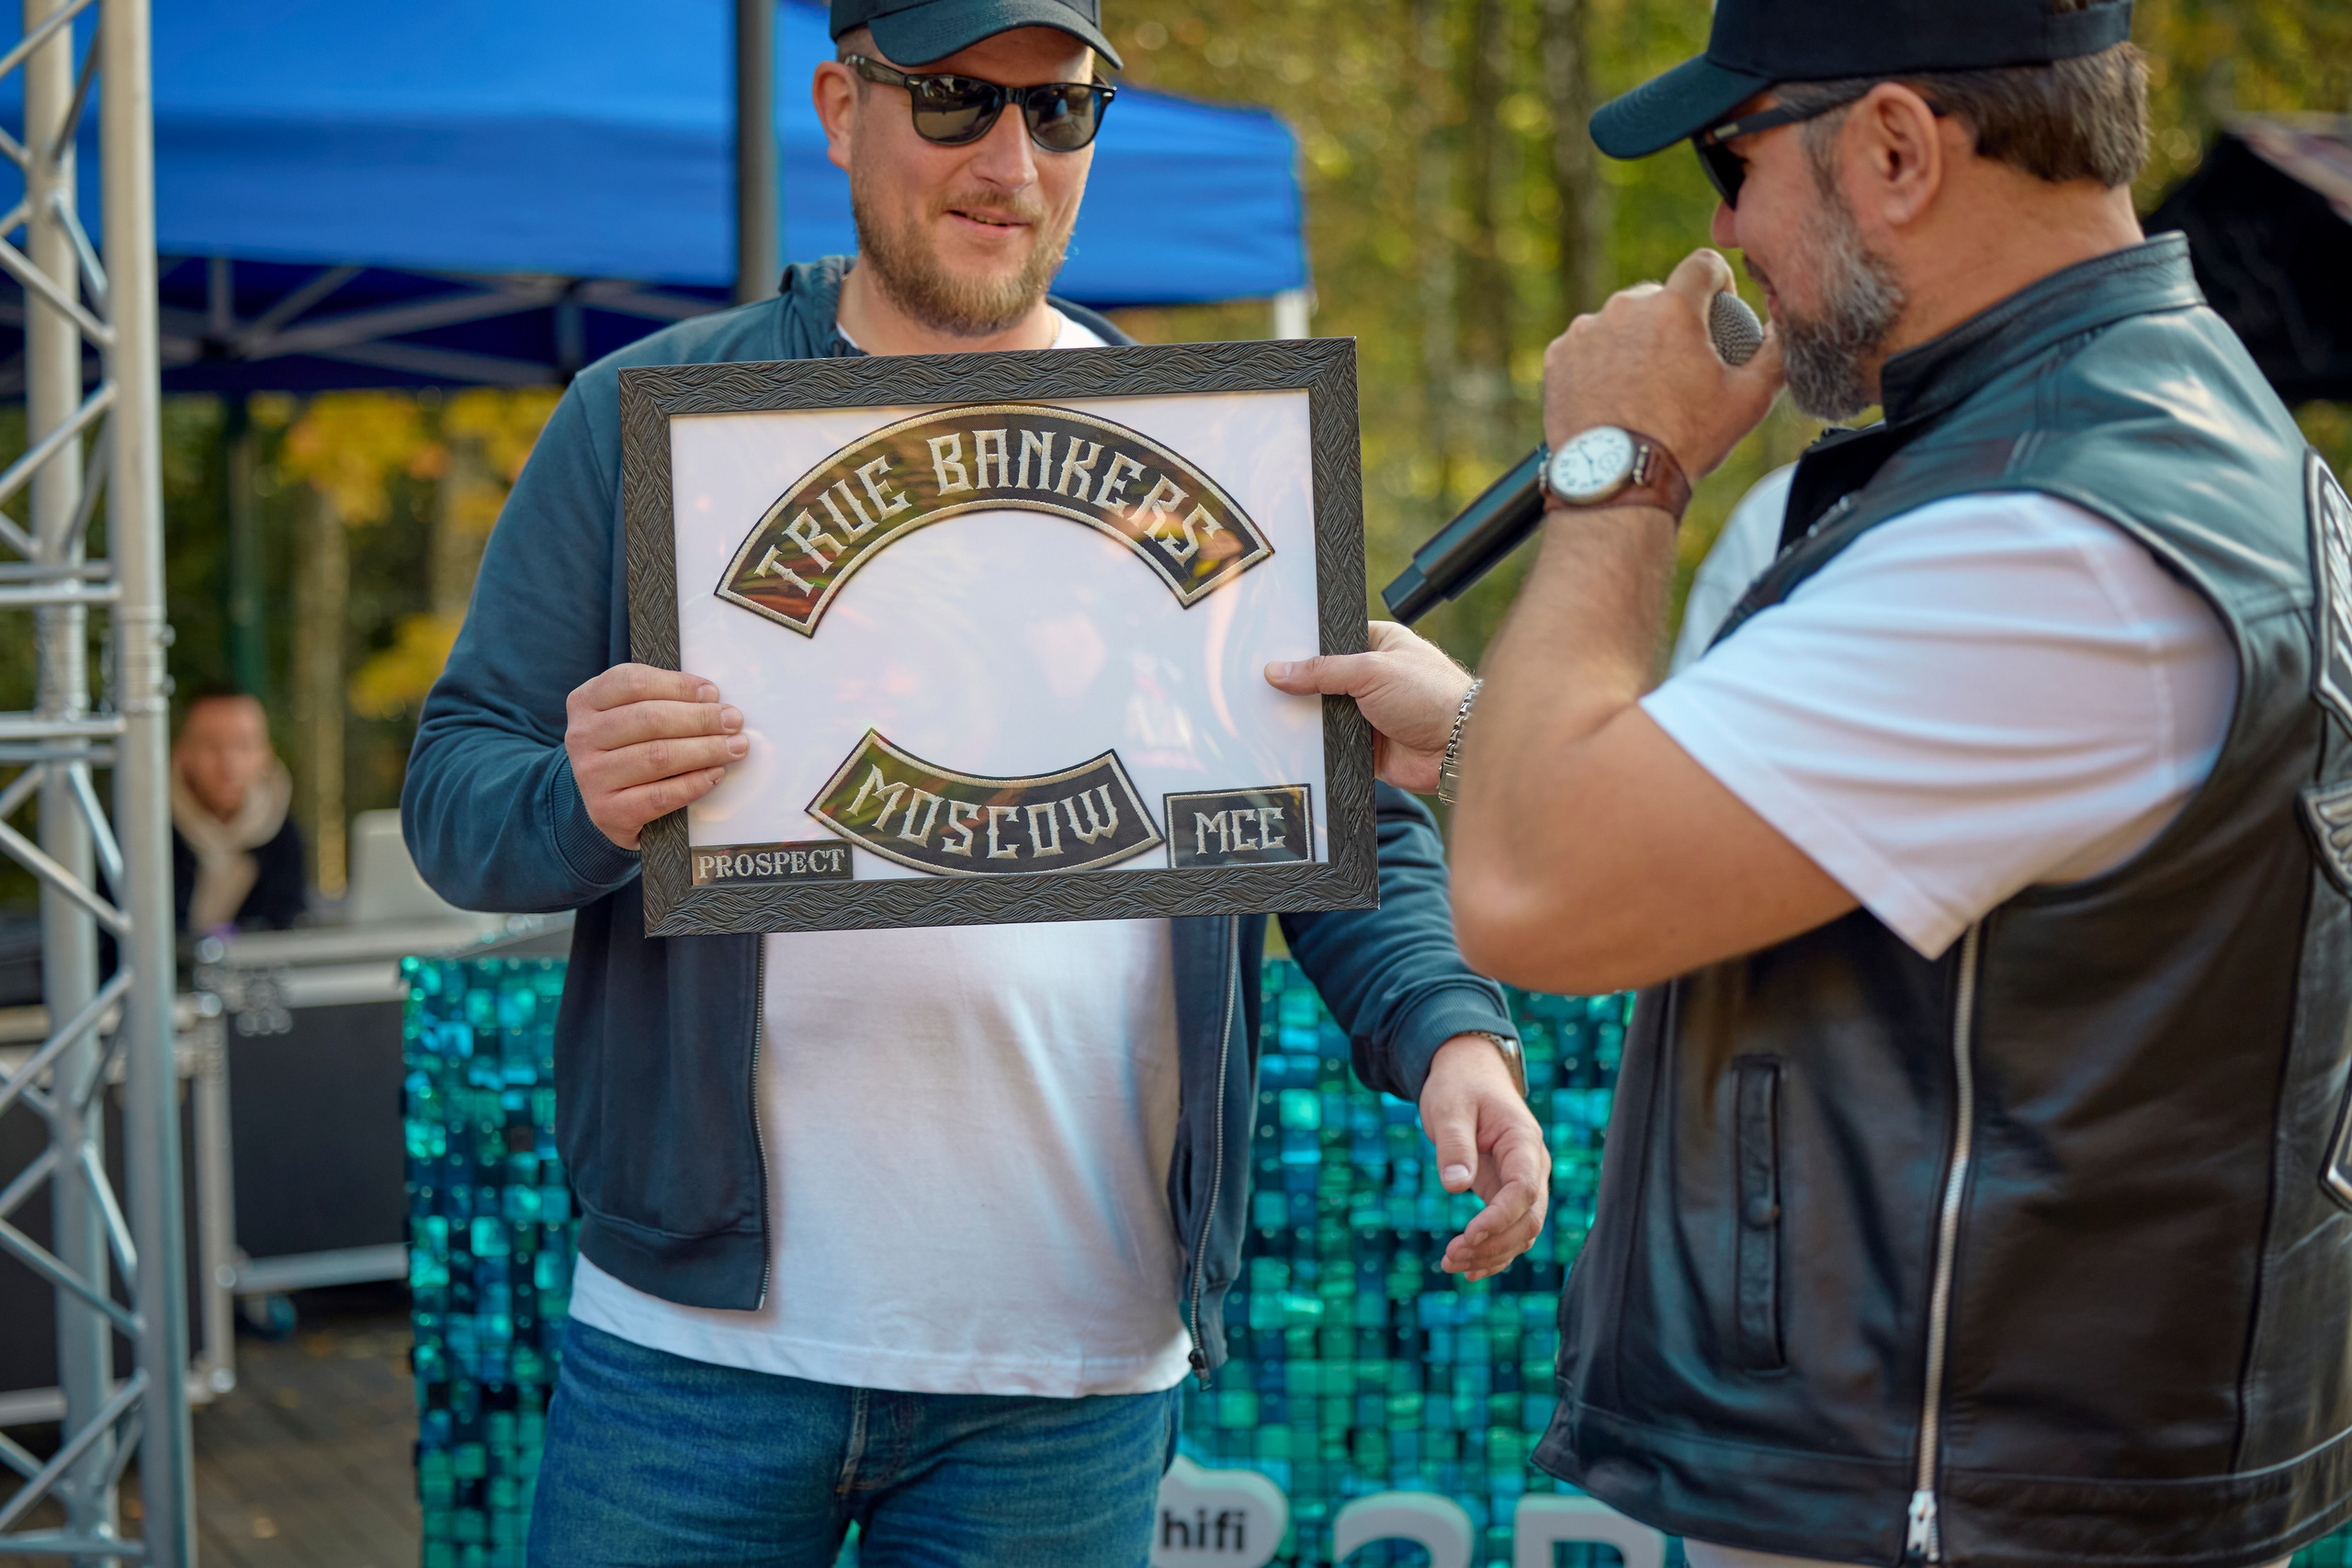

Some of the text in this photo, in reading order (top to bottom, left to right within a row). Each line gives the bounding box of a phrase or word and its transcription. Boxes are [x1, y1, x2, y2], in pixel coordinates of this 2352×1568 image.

[753, 428, 1223, 597] TRUE BANKERS
[846, 763, 1118, 859] MOSCOW
[1193, 807, 1286, 855] MCC
[697, 848, 845, 879] PROSPECT
[1161, 1508, 1245, 1551] hifi
